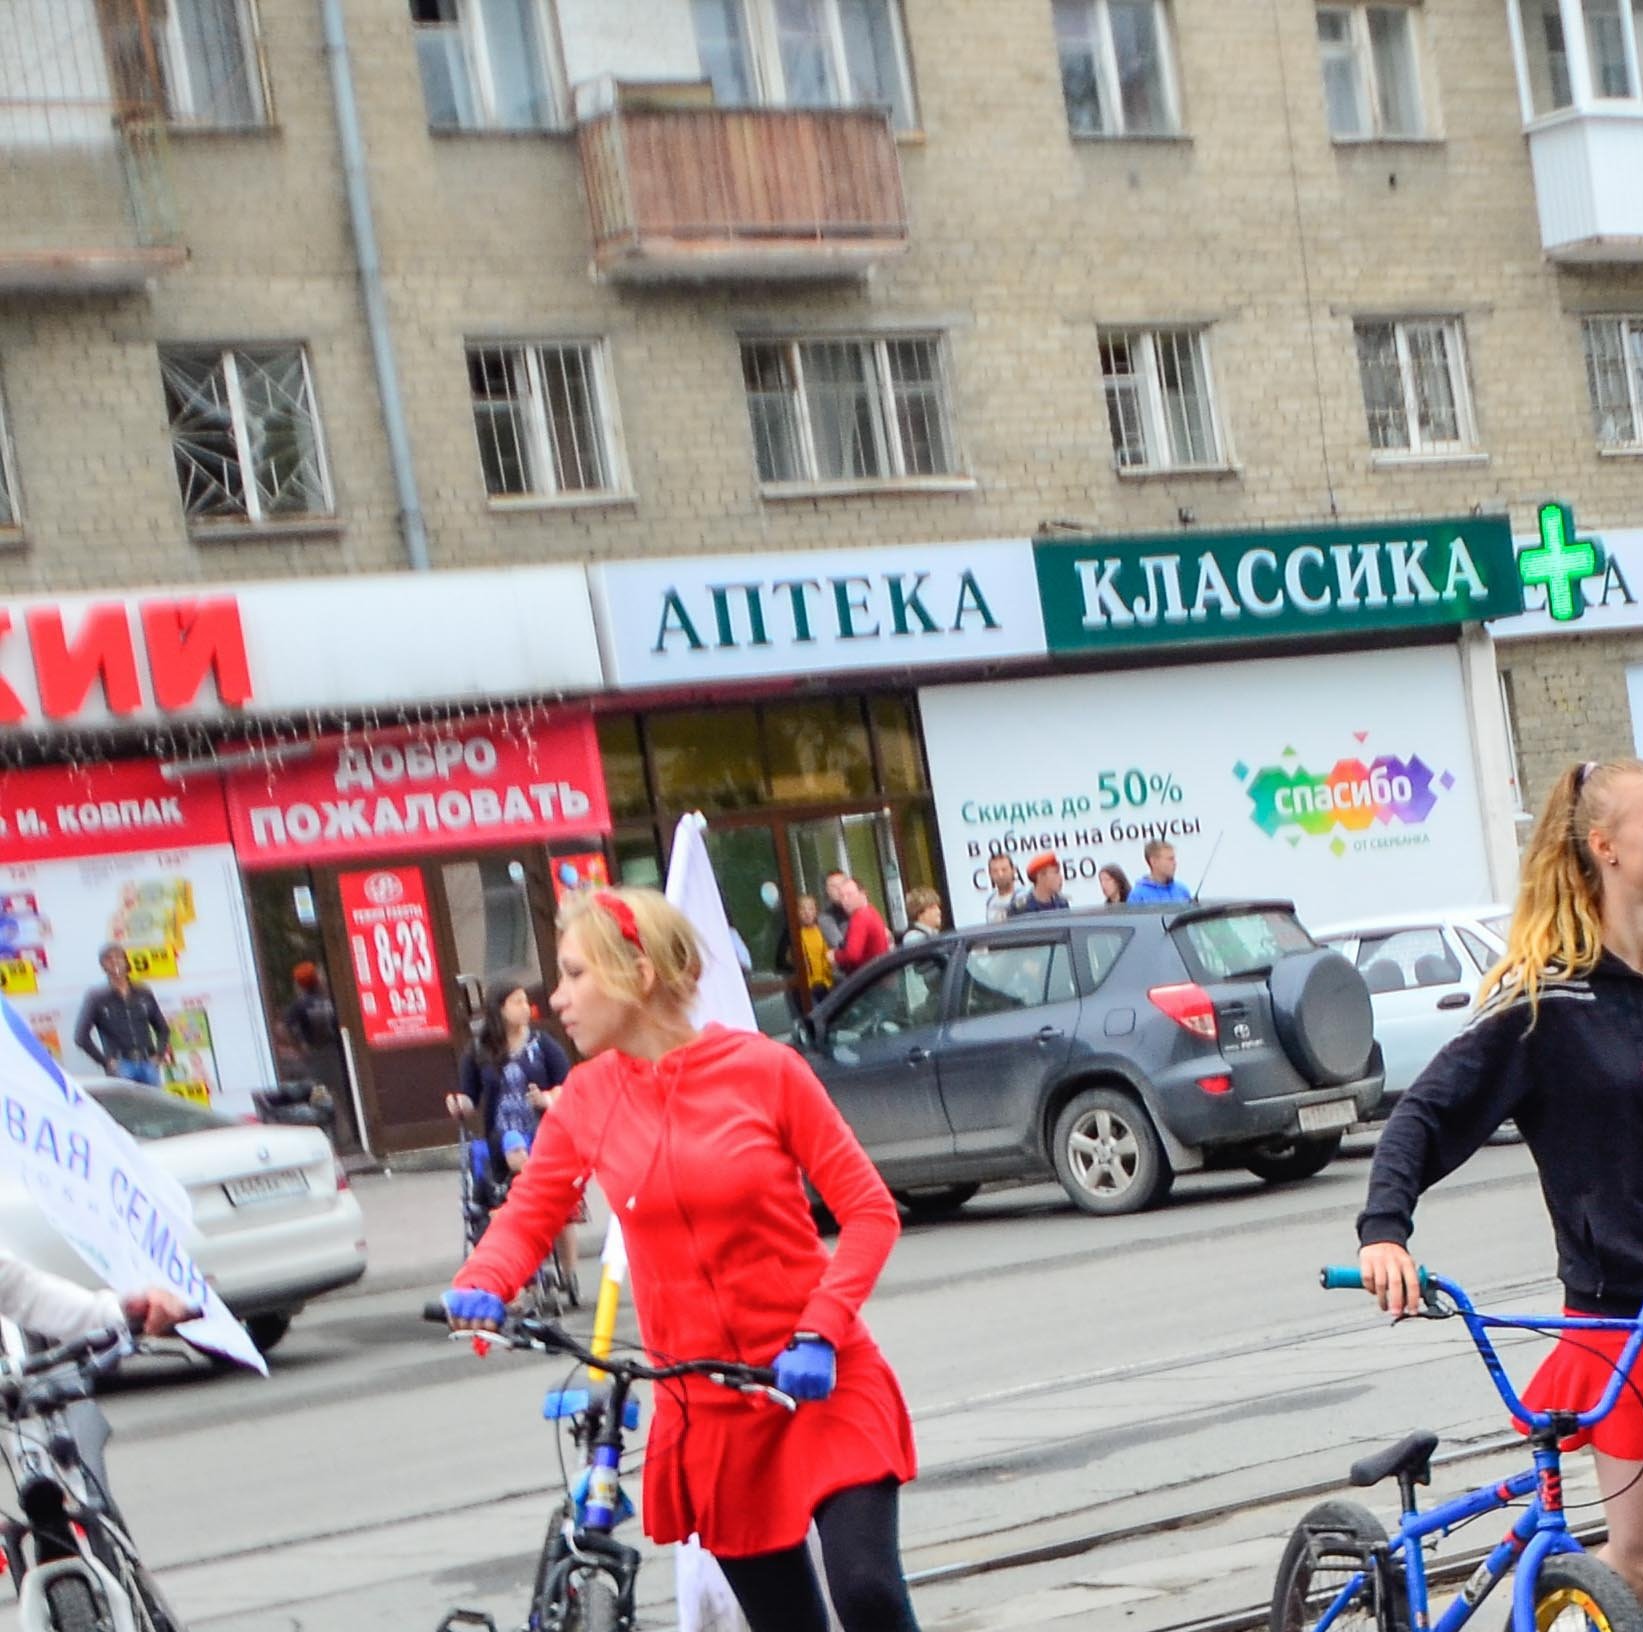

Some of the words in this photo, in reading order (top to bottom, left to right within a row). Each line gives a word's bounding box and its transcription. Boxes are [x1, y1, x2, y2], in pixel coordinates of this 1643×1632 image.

[650, 566, 1004, 654] АПТЕКА
[1074, 535, 1490, 630] КЛАССИКА
[334, 736, 498, 792] ДОБРО
[1274, 765, 1413, 816] спасибо
[56, 796, 186, 834] КОВПАК
[249, 780, 590, 850] ПОЖАЛОВАТЬ
[961, 797, 1054, 826] Скидка
[1061, 795, 1091, 819] до
[1097, 767, 1183, 810] 50%
[967, 840, 981, 858] в
[988, 827, 1068, 858] обмен
[1075, 824, 1103, 846] на
[1109, 816, 1201, 842] бонусы
[373, 919, 433, 986] 8-23
